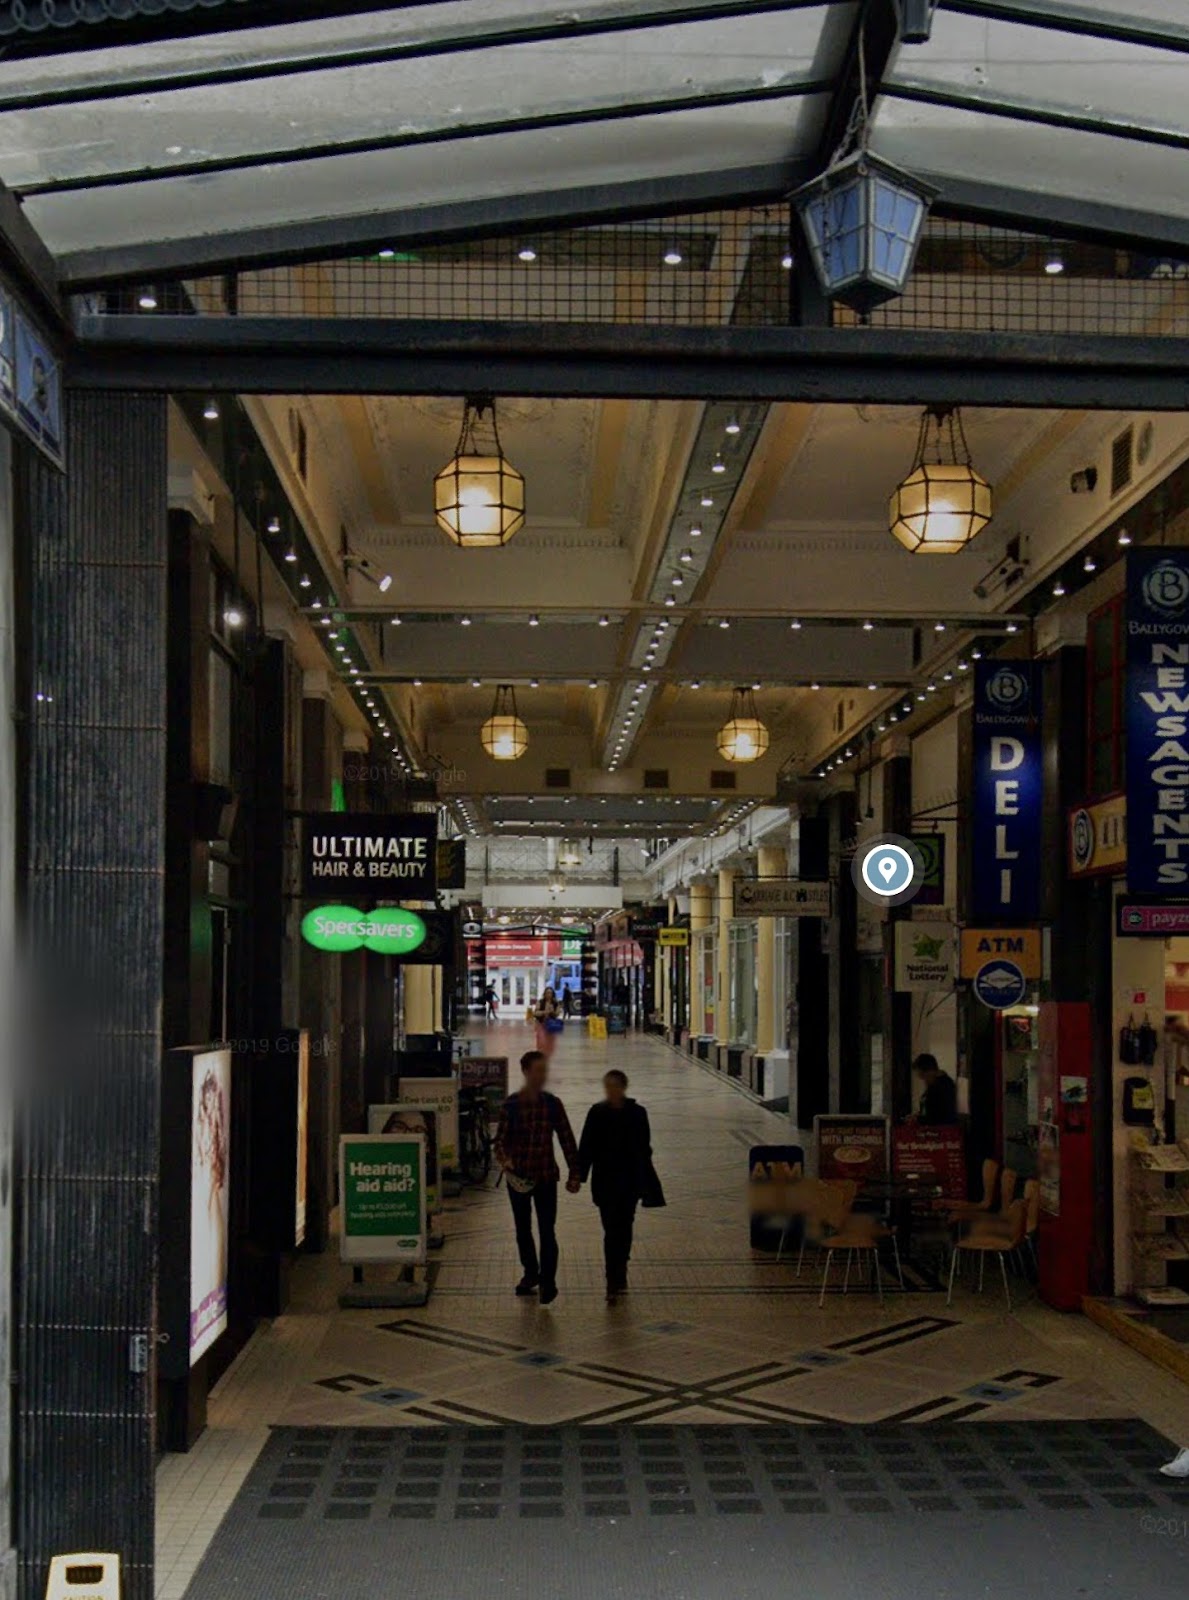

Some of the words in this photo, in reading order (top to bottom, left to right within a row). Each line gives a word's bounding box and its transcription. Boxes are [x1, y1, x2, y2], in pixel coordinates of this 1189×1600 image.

[990, 736, 1025, 904] DELI
[312, 835, 428, 860] ULTIMATE
[312, 861, 349, 877] HAIR
[353, 862, 366, 878] &
[368, 861, 427, 879] BEAUTY
[313, 914, 418, 941] Specsavers
[976, 937, 1024, 953] ATM
[906, 963, 949, 973] National
[908, 972, 947, 983] Lottery
[350, 1162, 412, 1178] Hearing
[356, 1179, 380, 1193] aid
[383, 1178, 416, 1193] aid?
